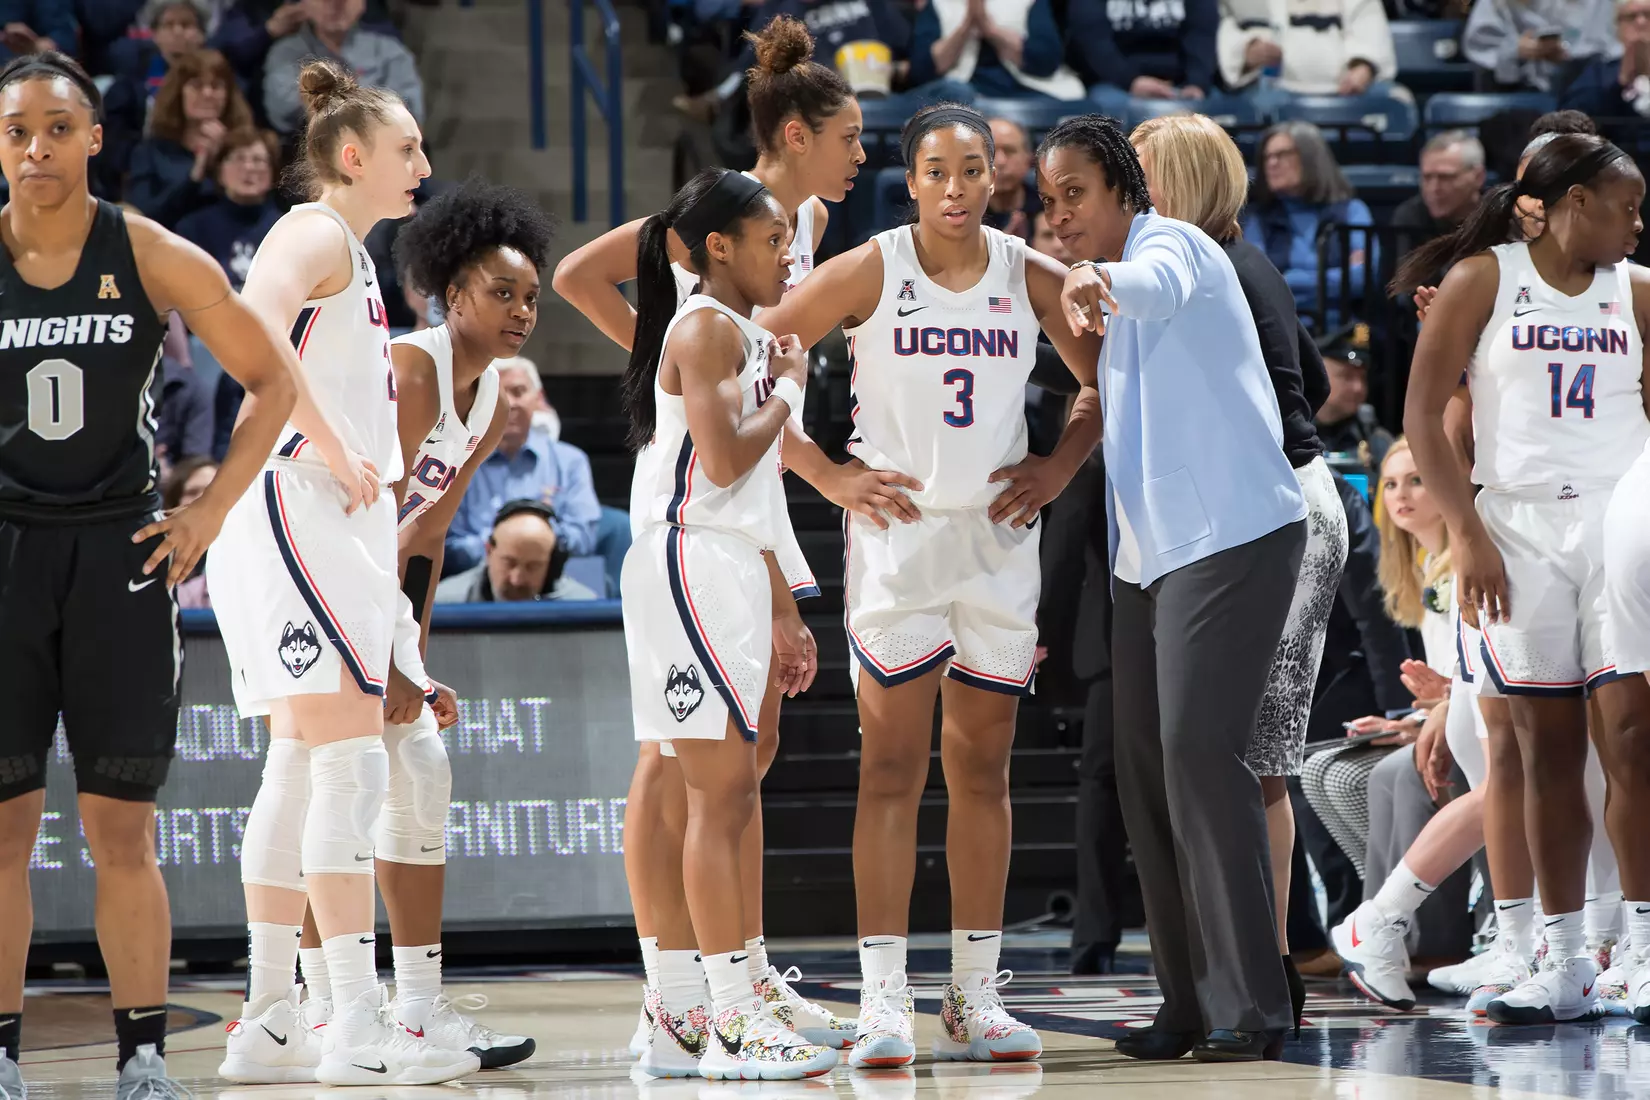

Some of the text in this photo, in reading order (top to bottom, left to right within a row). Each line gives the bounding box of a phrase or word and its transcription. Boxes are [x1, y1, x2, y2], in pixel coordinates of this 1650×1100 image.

[0, 314, 135, 350] NIGHTS
[893, 327, 1018, 358] UCONN
[1512, 325, 1628, 355] UCONN
[26, 358, 84, 441] 0
[943, 368, 974, 428] 3
[1547, 363, 1596, 419] 14
